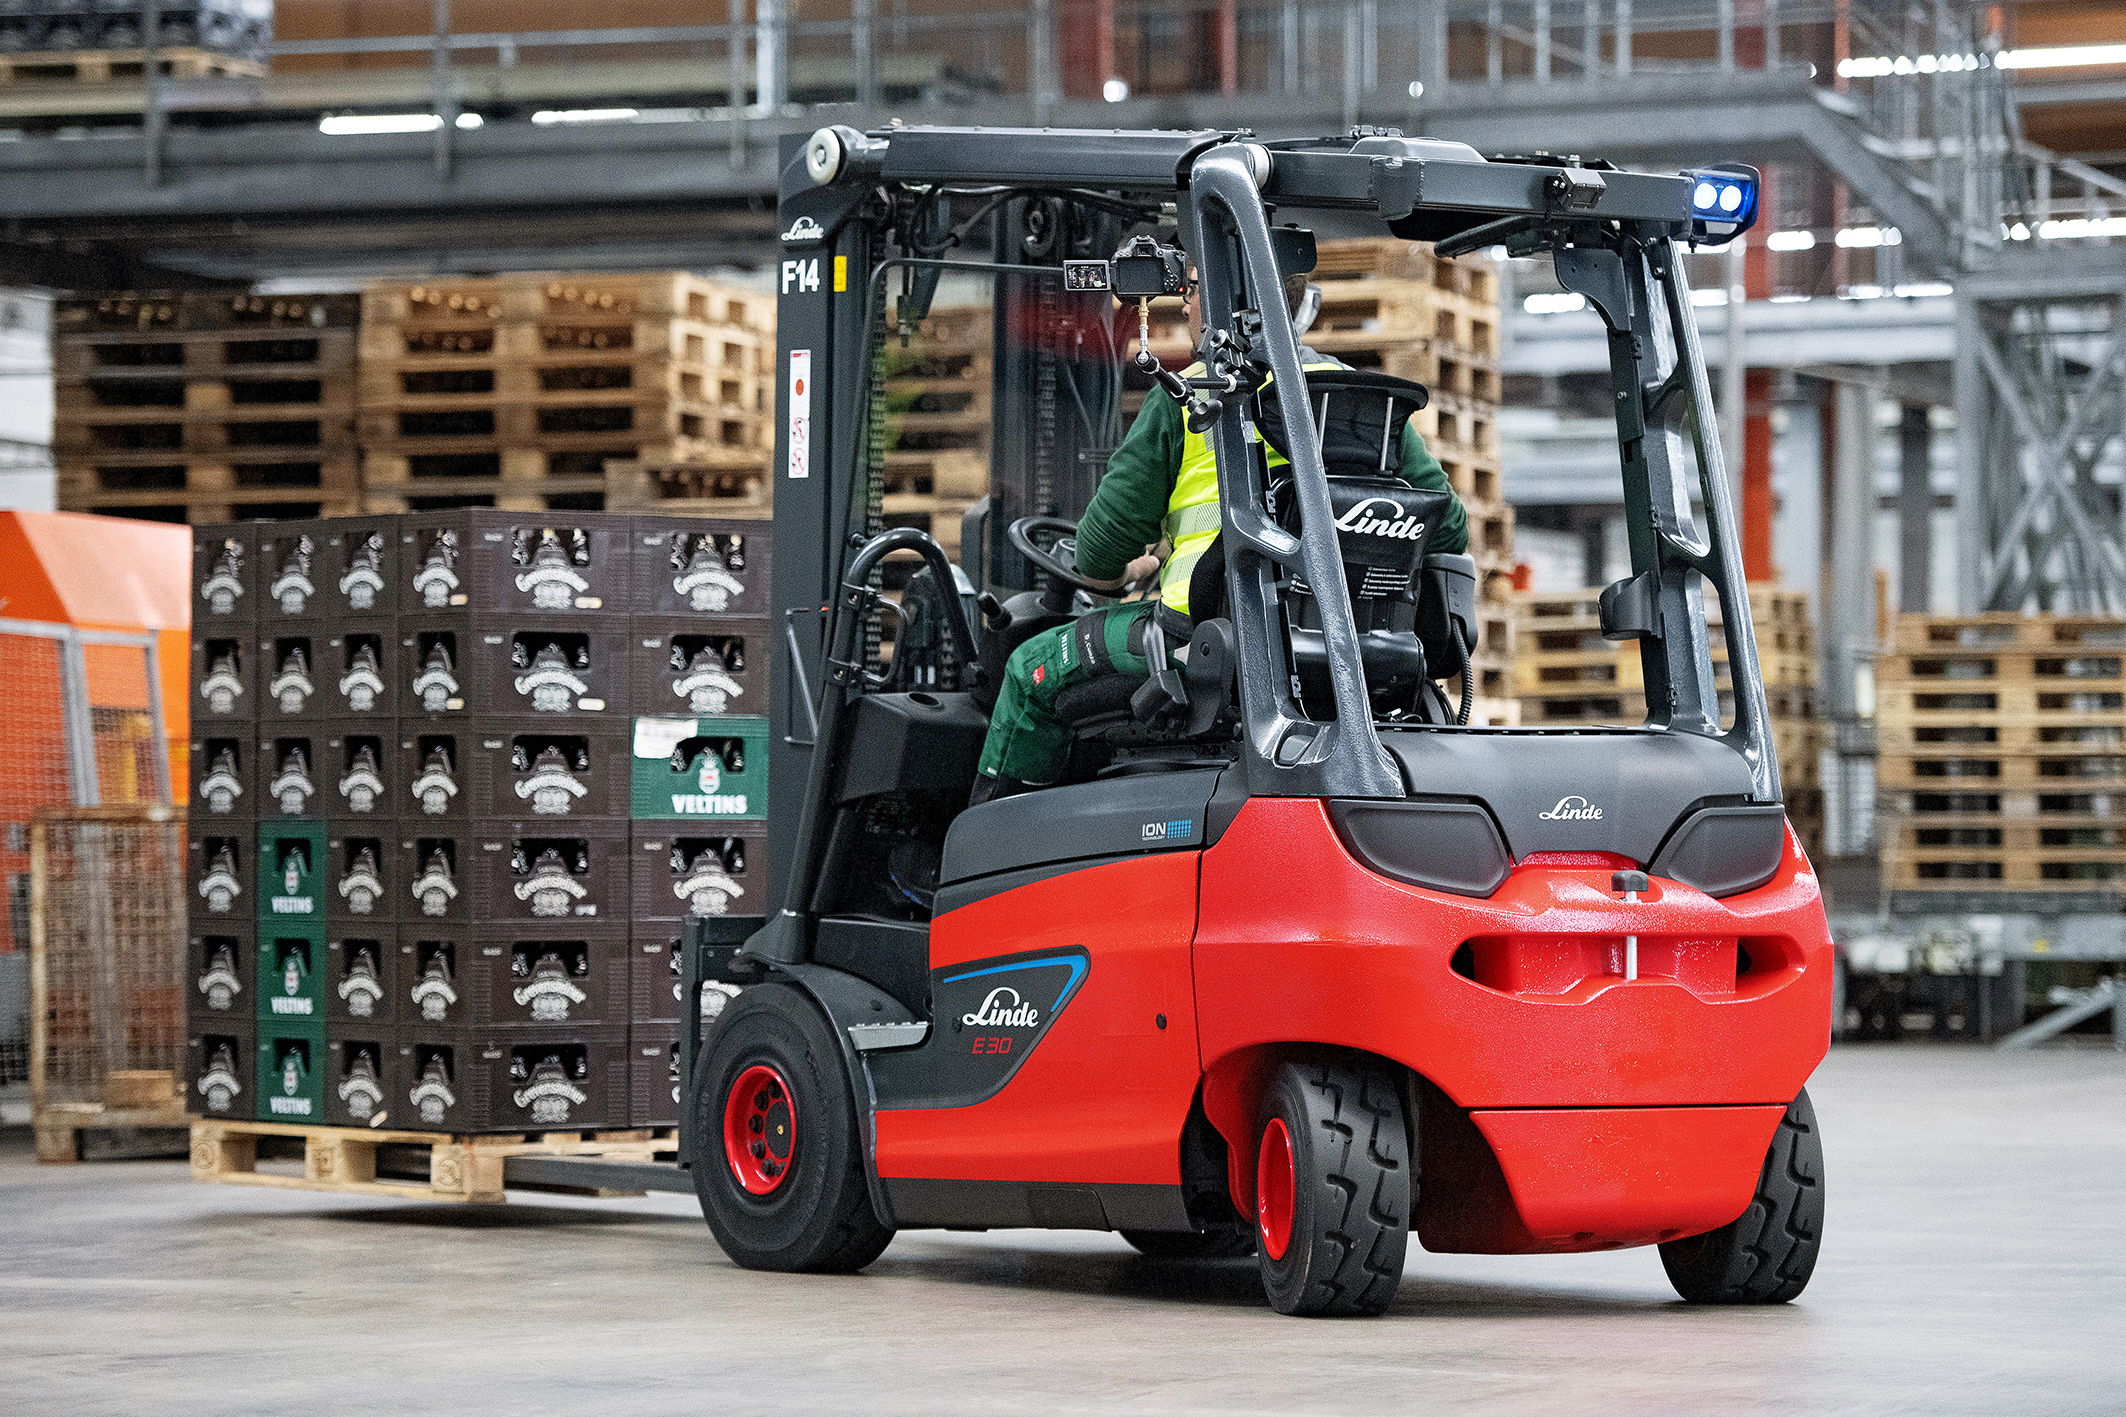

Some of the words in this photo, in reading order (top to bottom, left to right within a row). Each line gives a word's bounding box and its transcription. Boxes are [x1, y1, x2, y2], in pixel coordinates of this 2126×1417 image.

[781, 216, 824, 241] Linde
[782, 258, 820, 295] F14
[1334, 498, 1425, 541] Linde
[671, 794, 748, 814] VELTINS
[1538, 795, 1604, 820] Linde
[1142, 822, 1166, 837] ION
[962, 987, 1039, 1028] Linde
